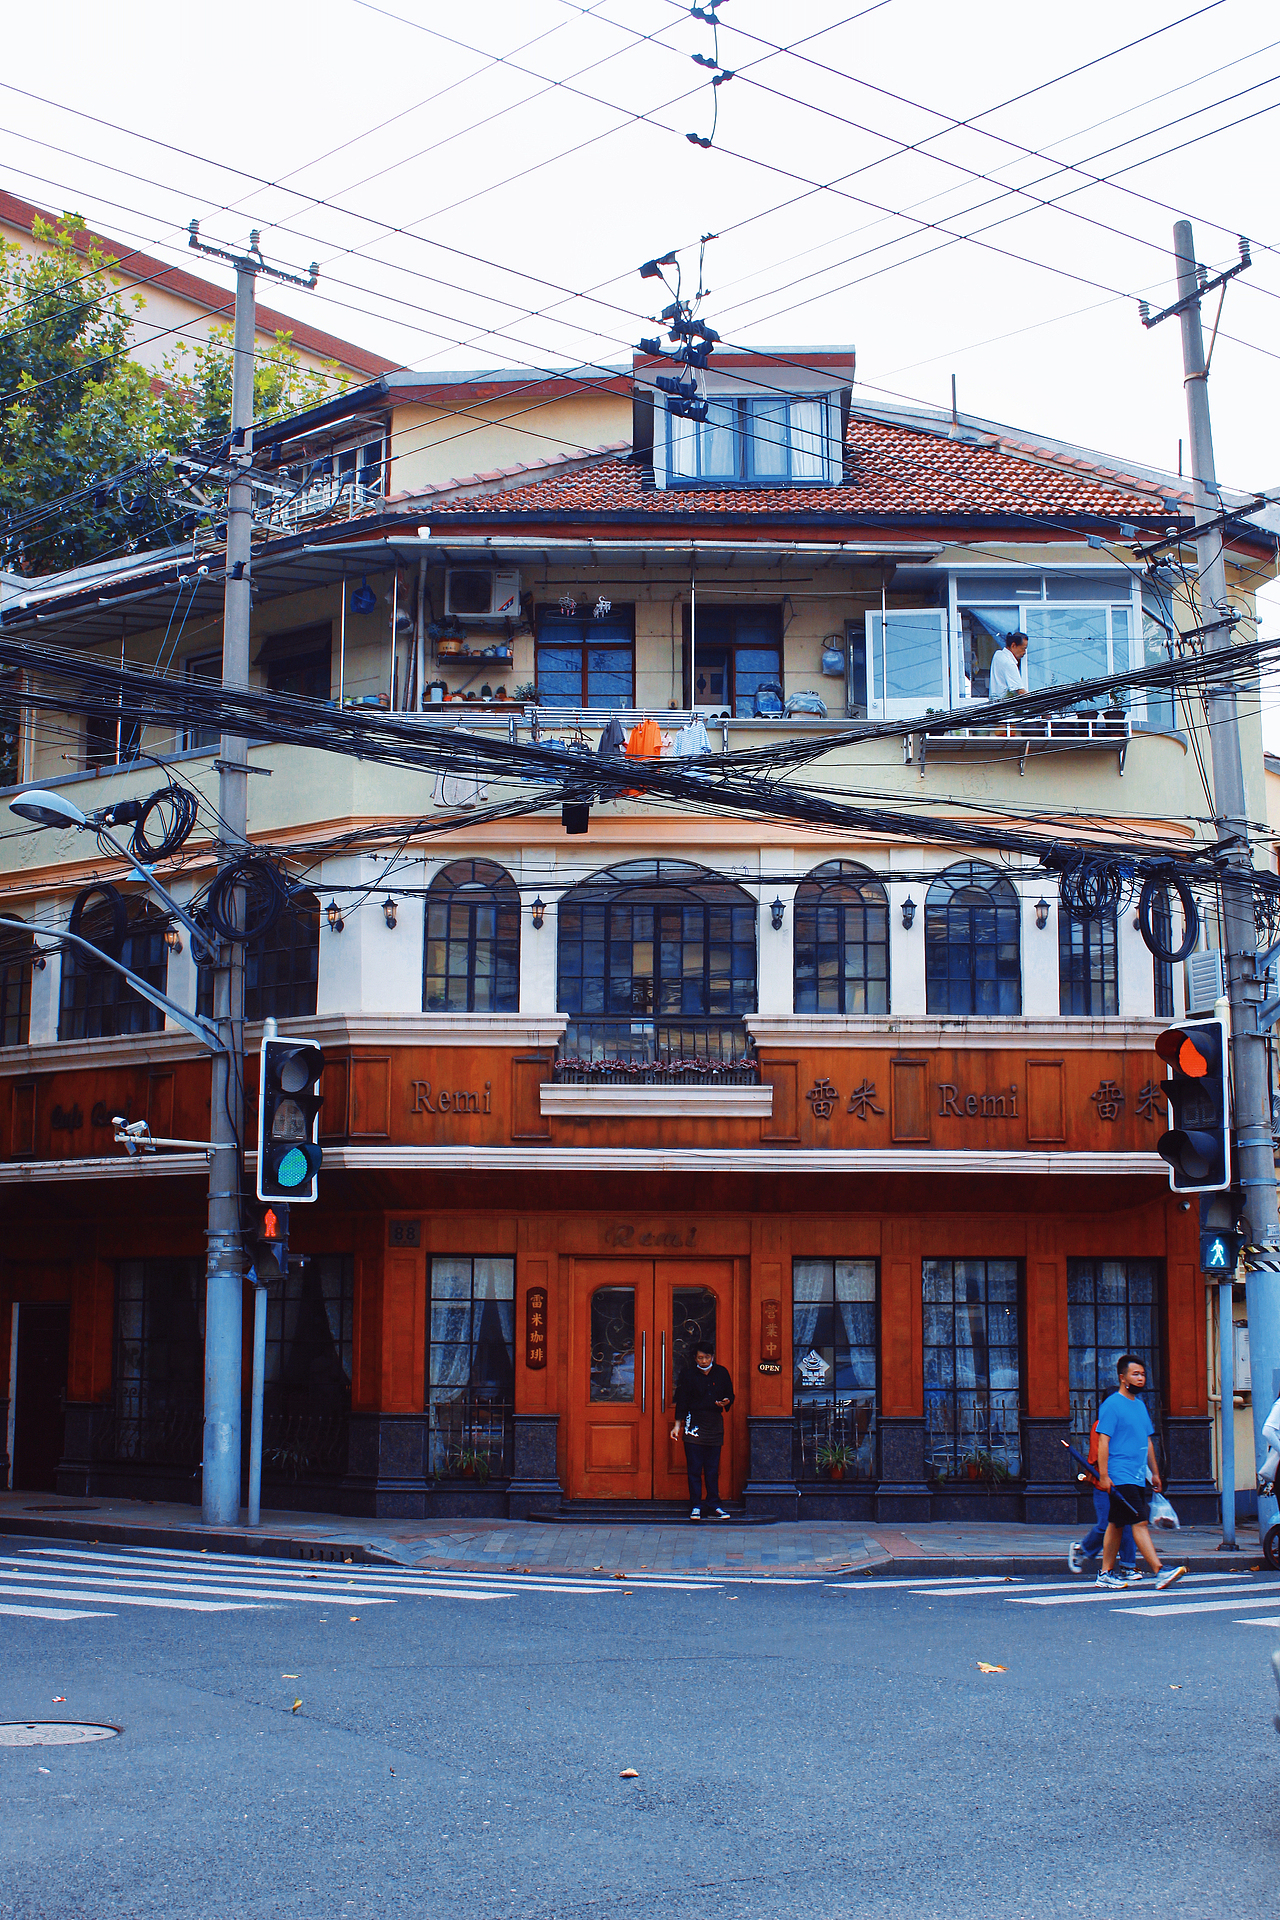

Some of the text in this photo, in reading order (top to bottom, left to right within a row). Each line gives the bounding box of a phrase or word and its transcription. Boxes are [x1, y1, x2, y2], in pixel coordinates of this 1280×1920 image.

[411, 1080, 491, 1114] Remi
[806, 1078, 885, 1121] 雷米
[938, 1084, 1019, 1118] Remi
[1090, 1080, 1167, 1121] 雷米
[394, 1226, 415, 1240] 88
[605, 1224, 698, 1247] Remi
[759, 1364, 780, 1372] OPEN
